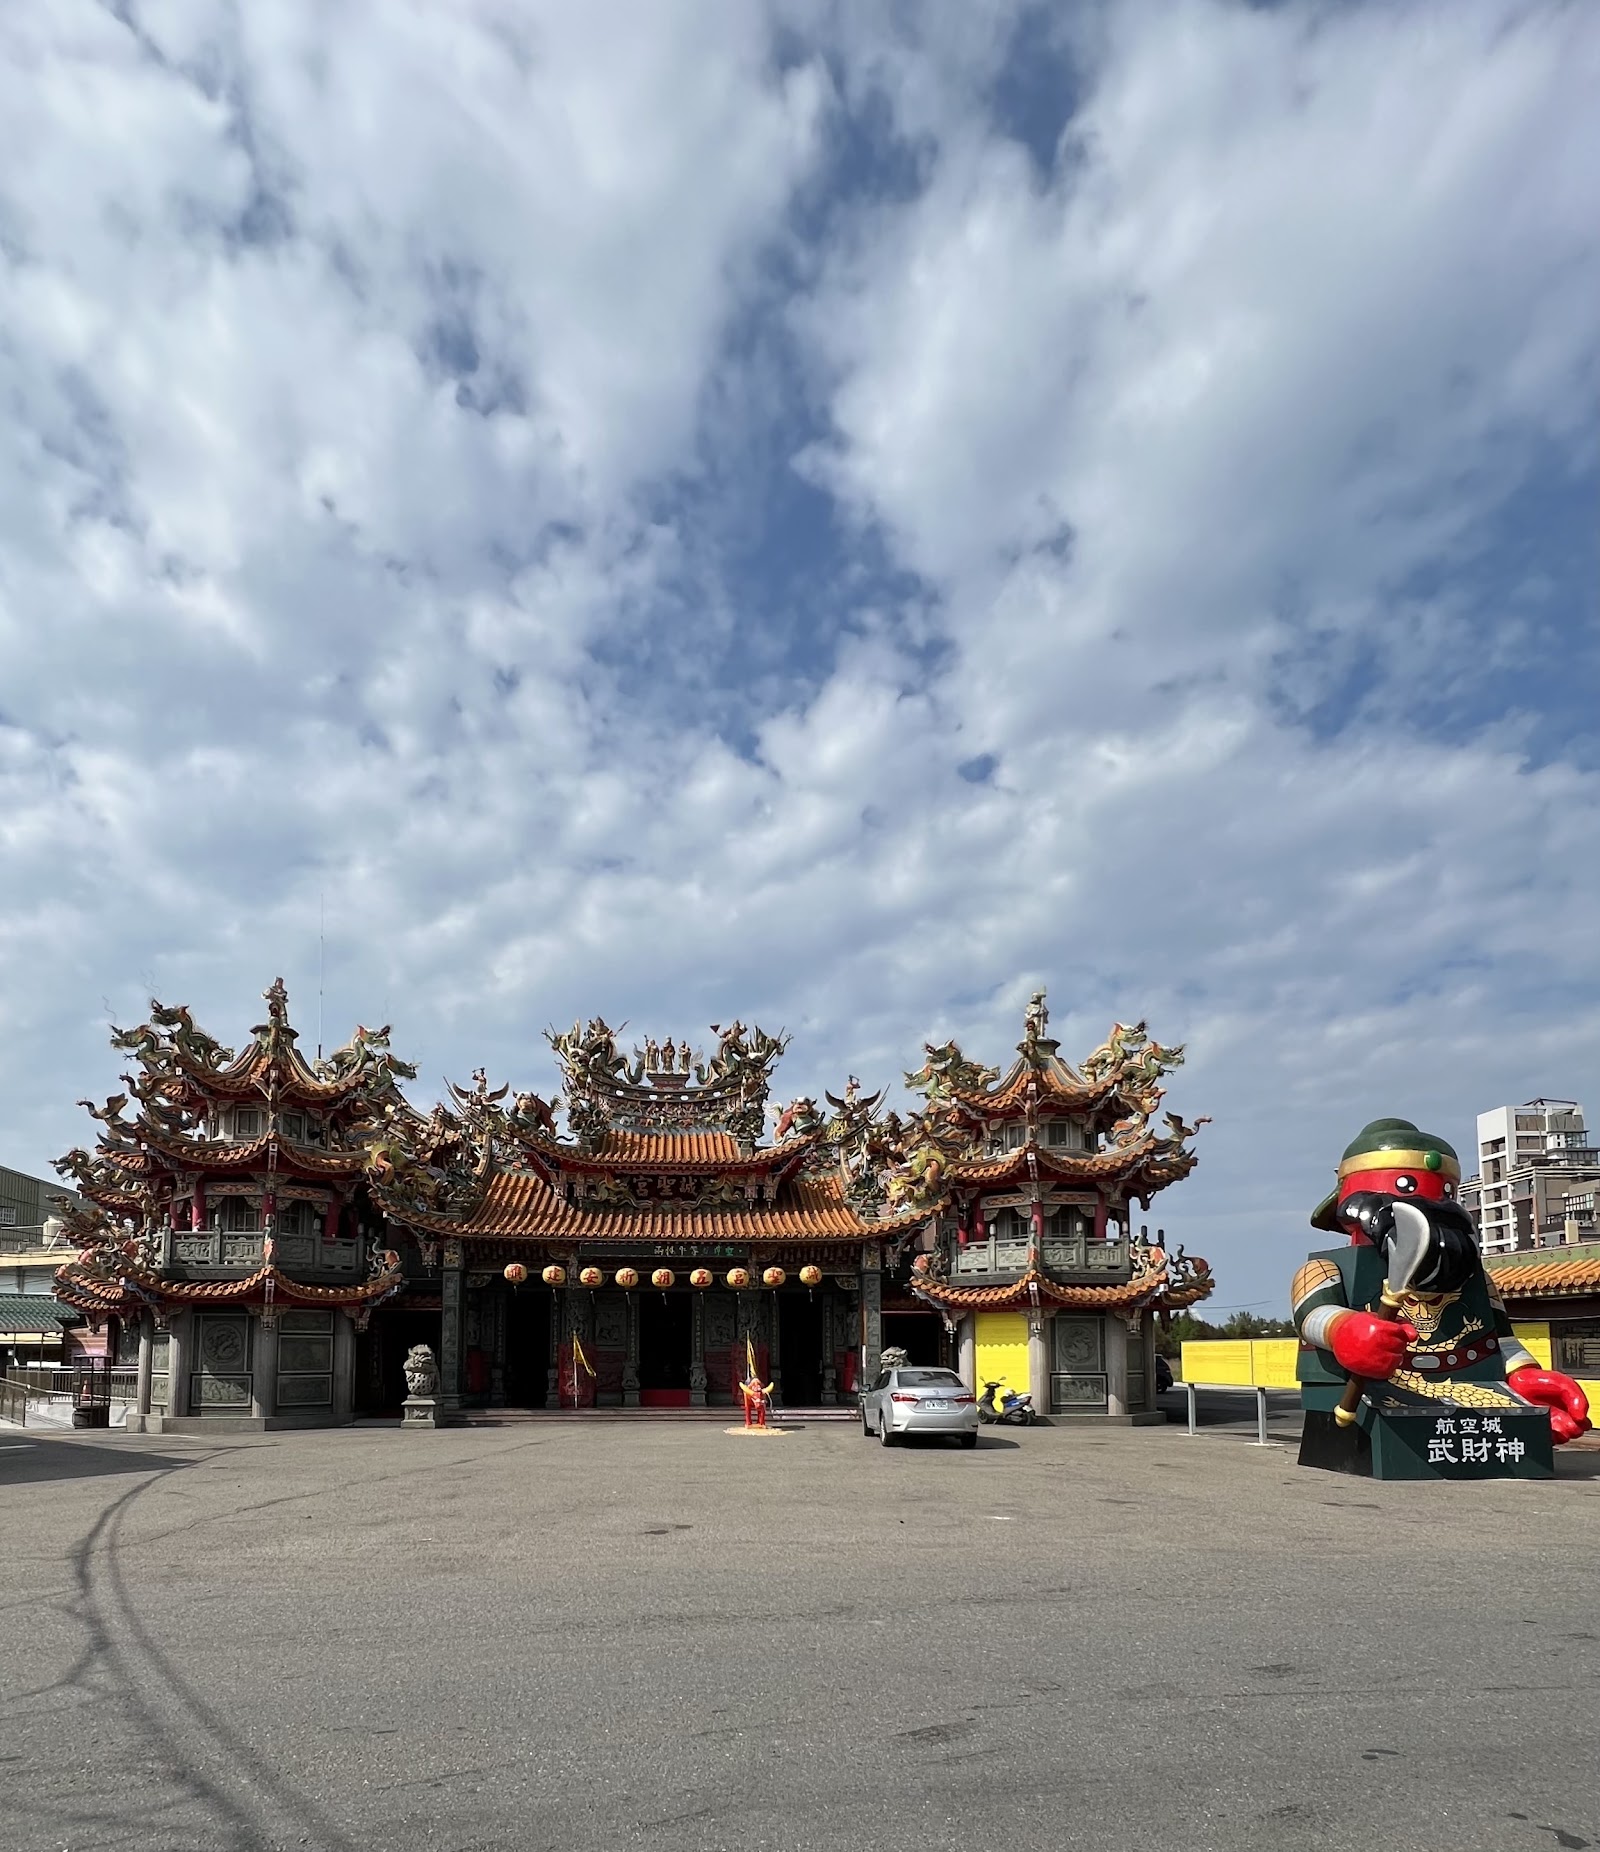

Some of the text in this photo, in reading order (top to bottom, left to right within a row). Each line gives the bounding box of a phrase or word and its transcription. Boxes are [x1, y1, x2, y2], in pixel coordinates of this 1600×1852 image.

[1435, 1417, 1503, 1435] 航空城
[1427, 1437, 1525, 1463] 武財神
